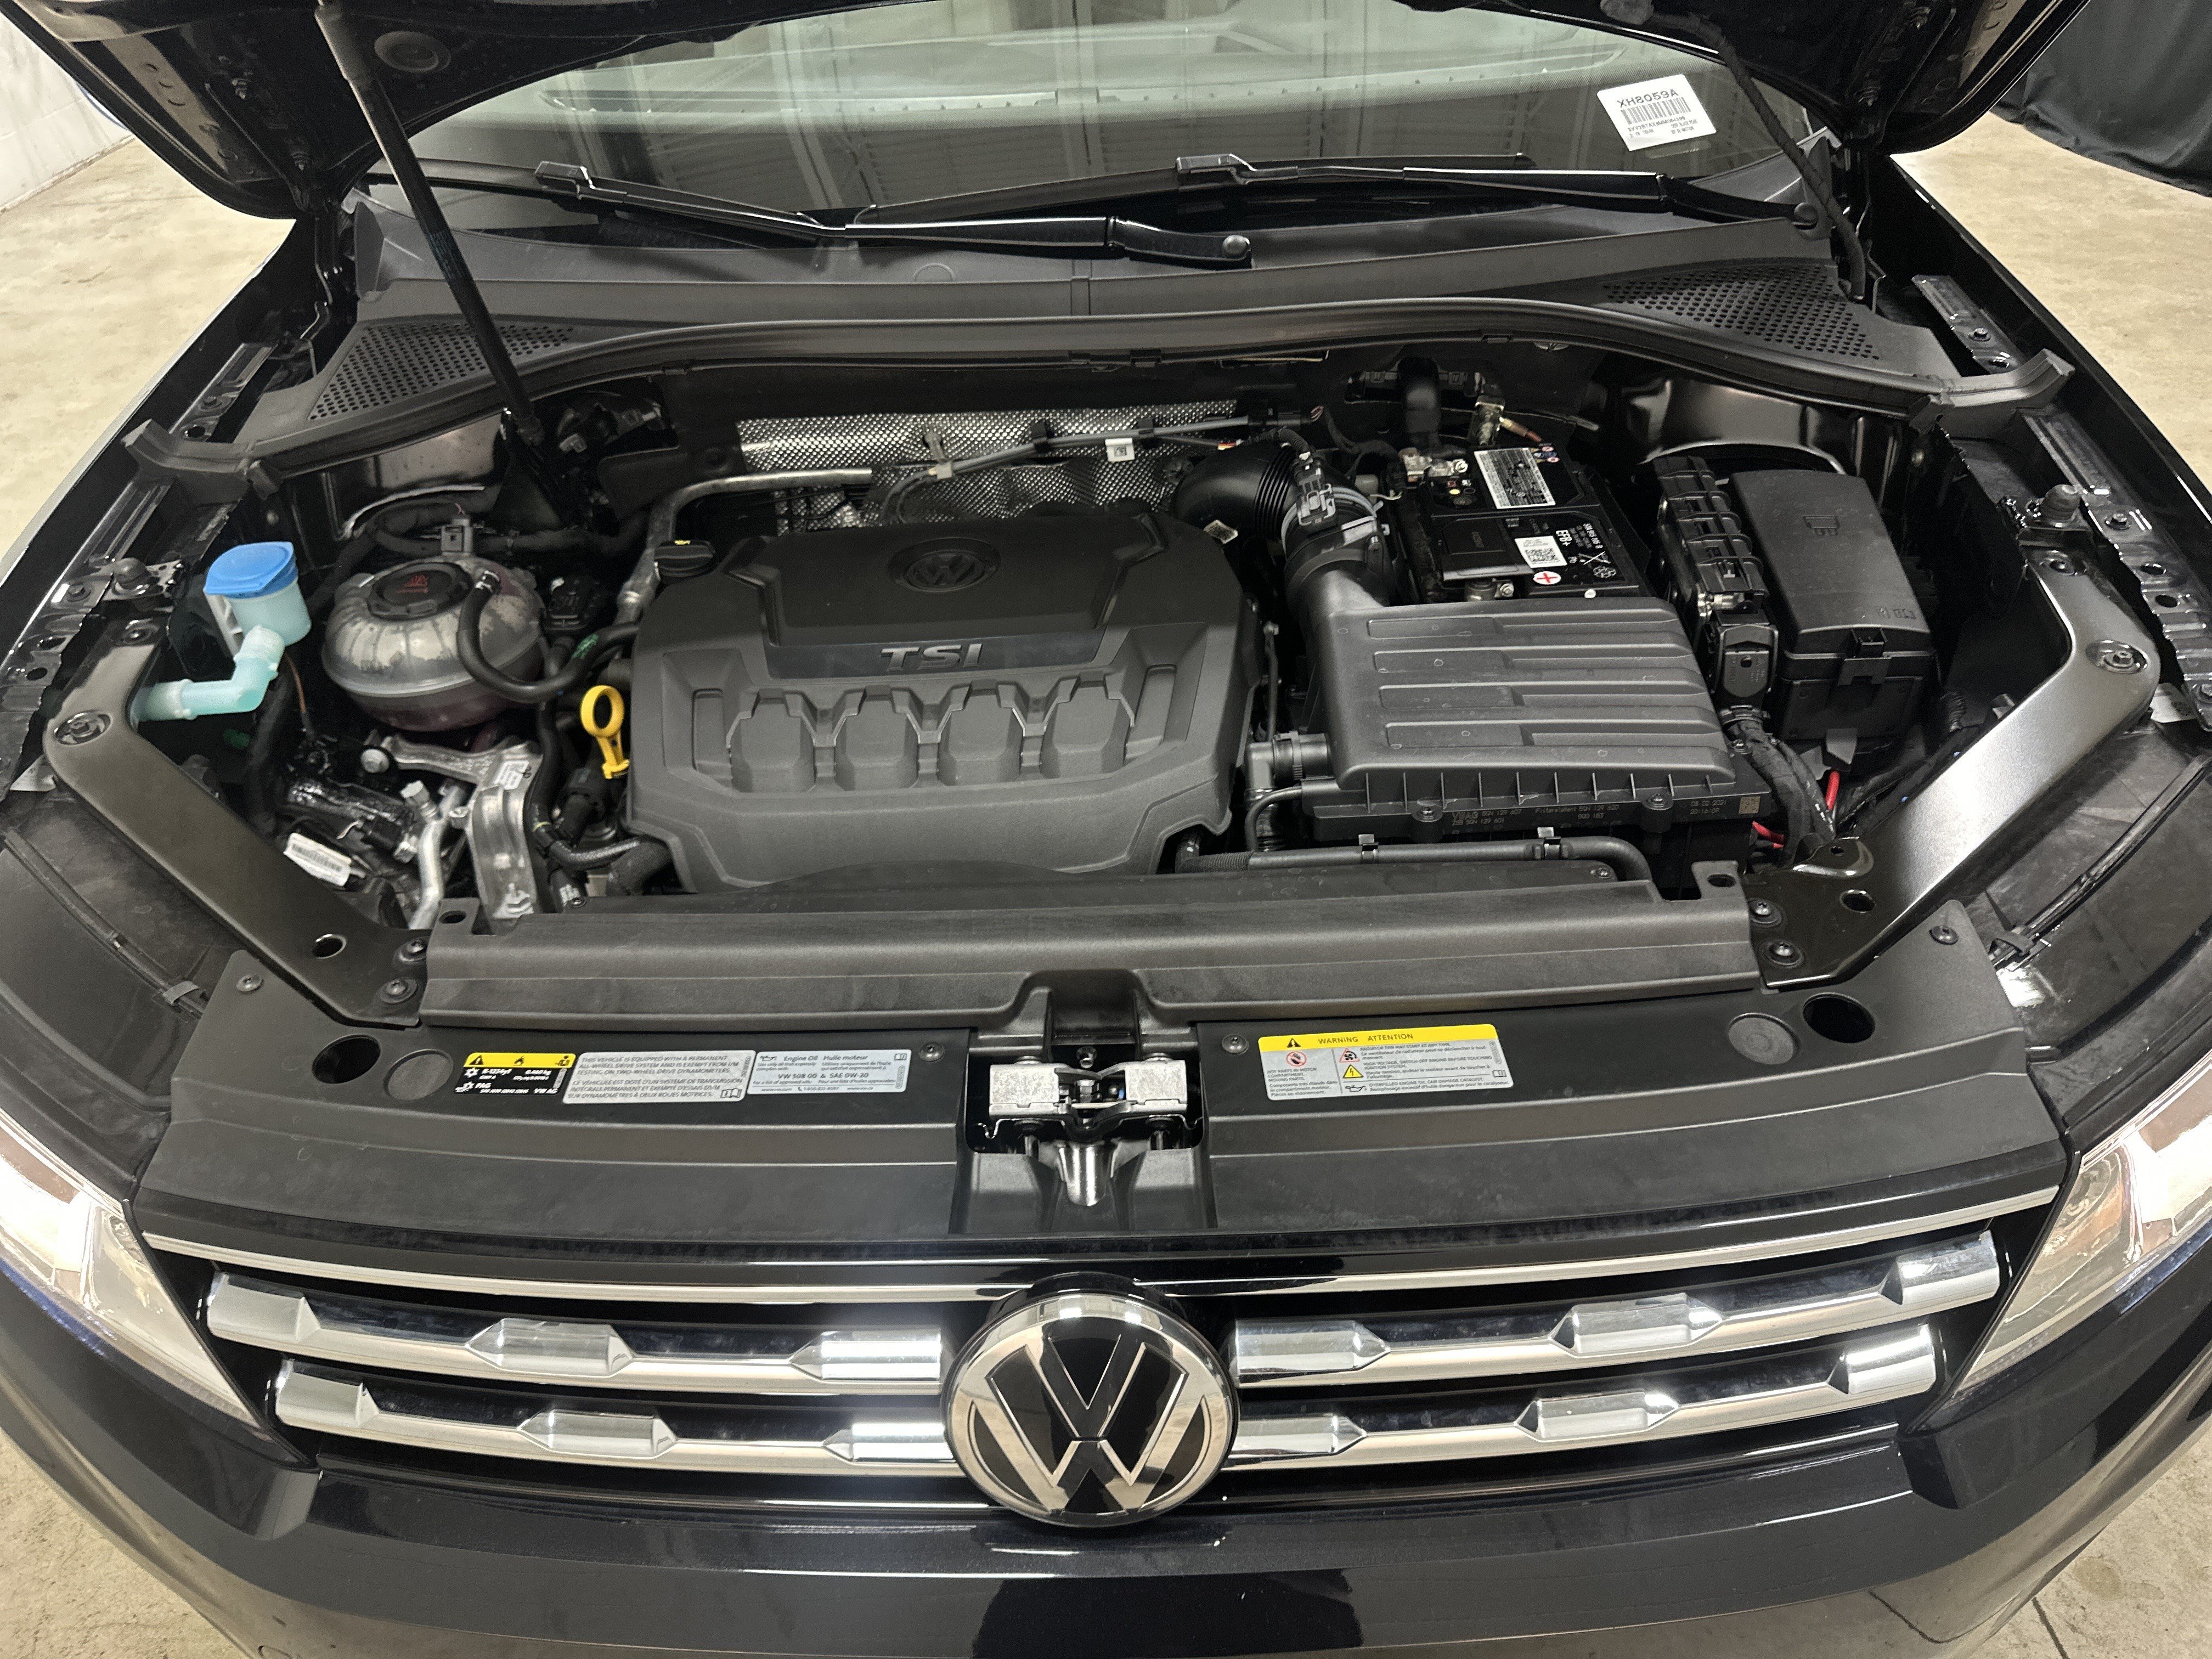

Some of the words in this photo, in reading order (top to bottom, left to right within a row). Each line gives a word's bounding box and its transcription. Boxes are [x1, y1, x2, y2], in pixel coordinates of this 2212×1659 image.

[1617, 89, 1679, 108] XH8059A
[879, 643, 983, 672] TSI
[1318, 1035, 1358, 1045] WARNING
[1368, 1032, 1413, 1042] ATTENTION
